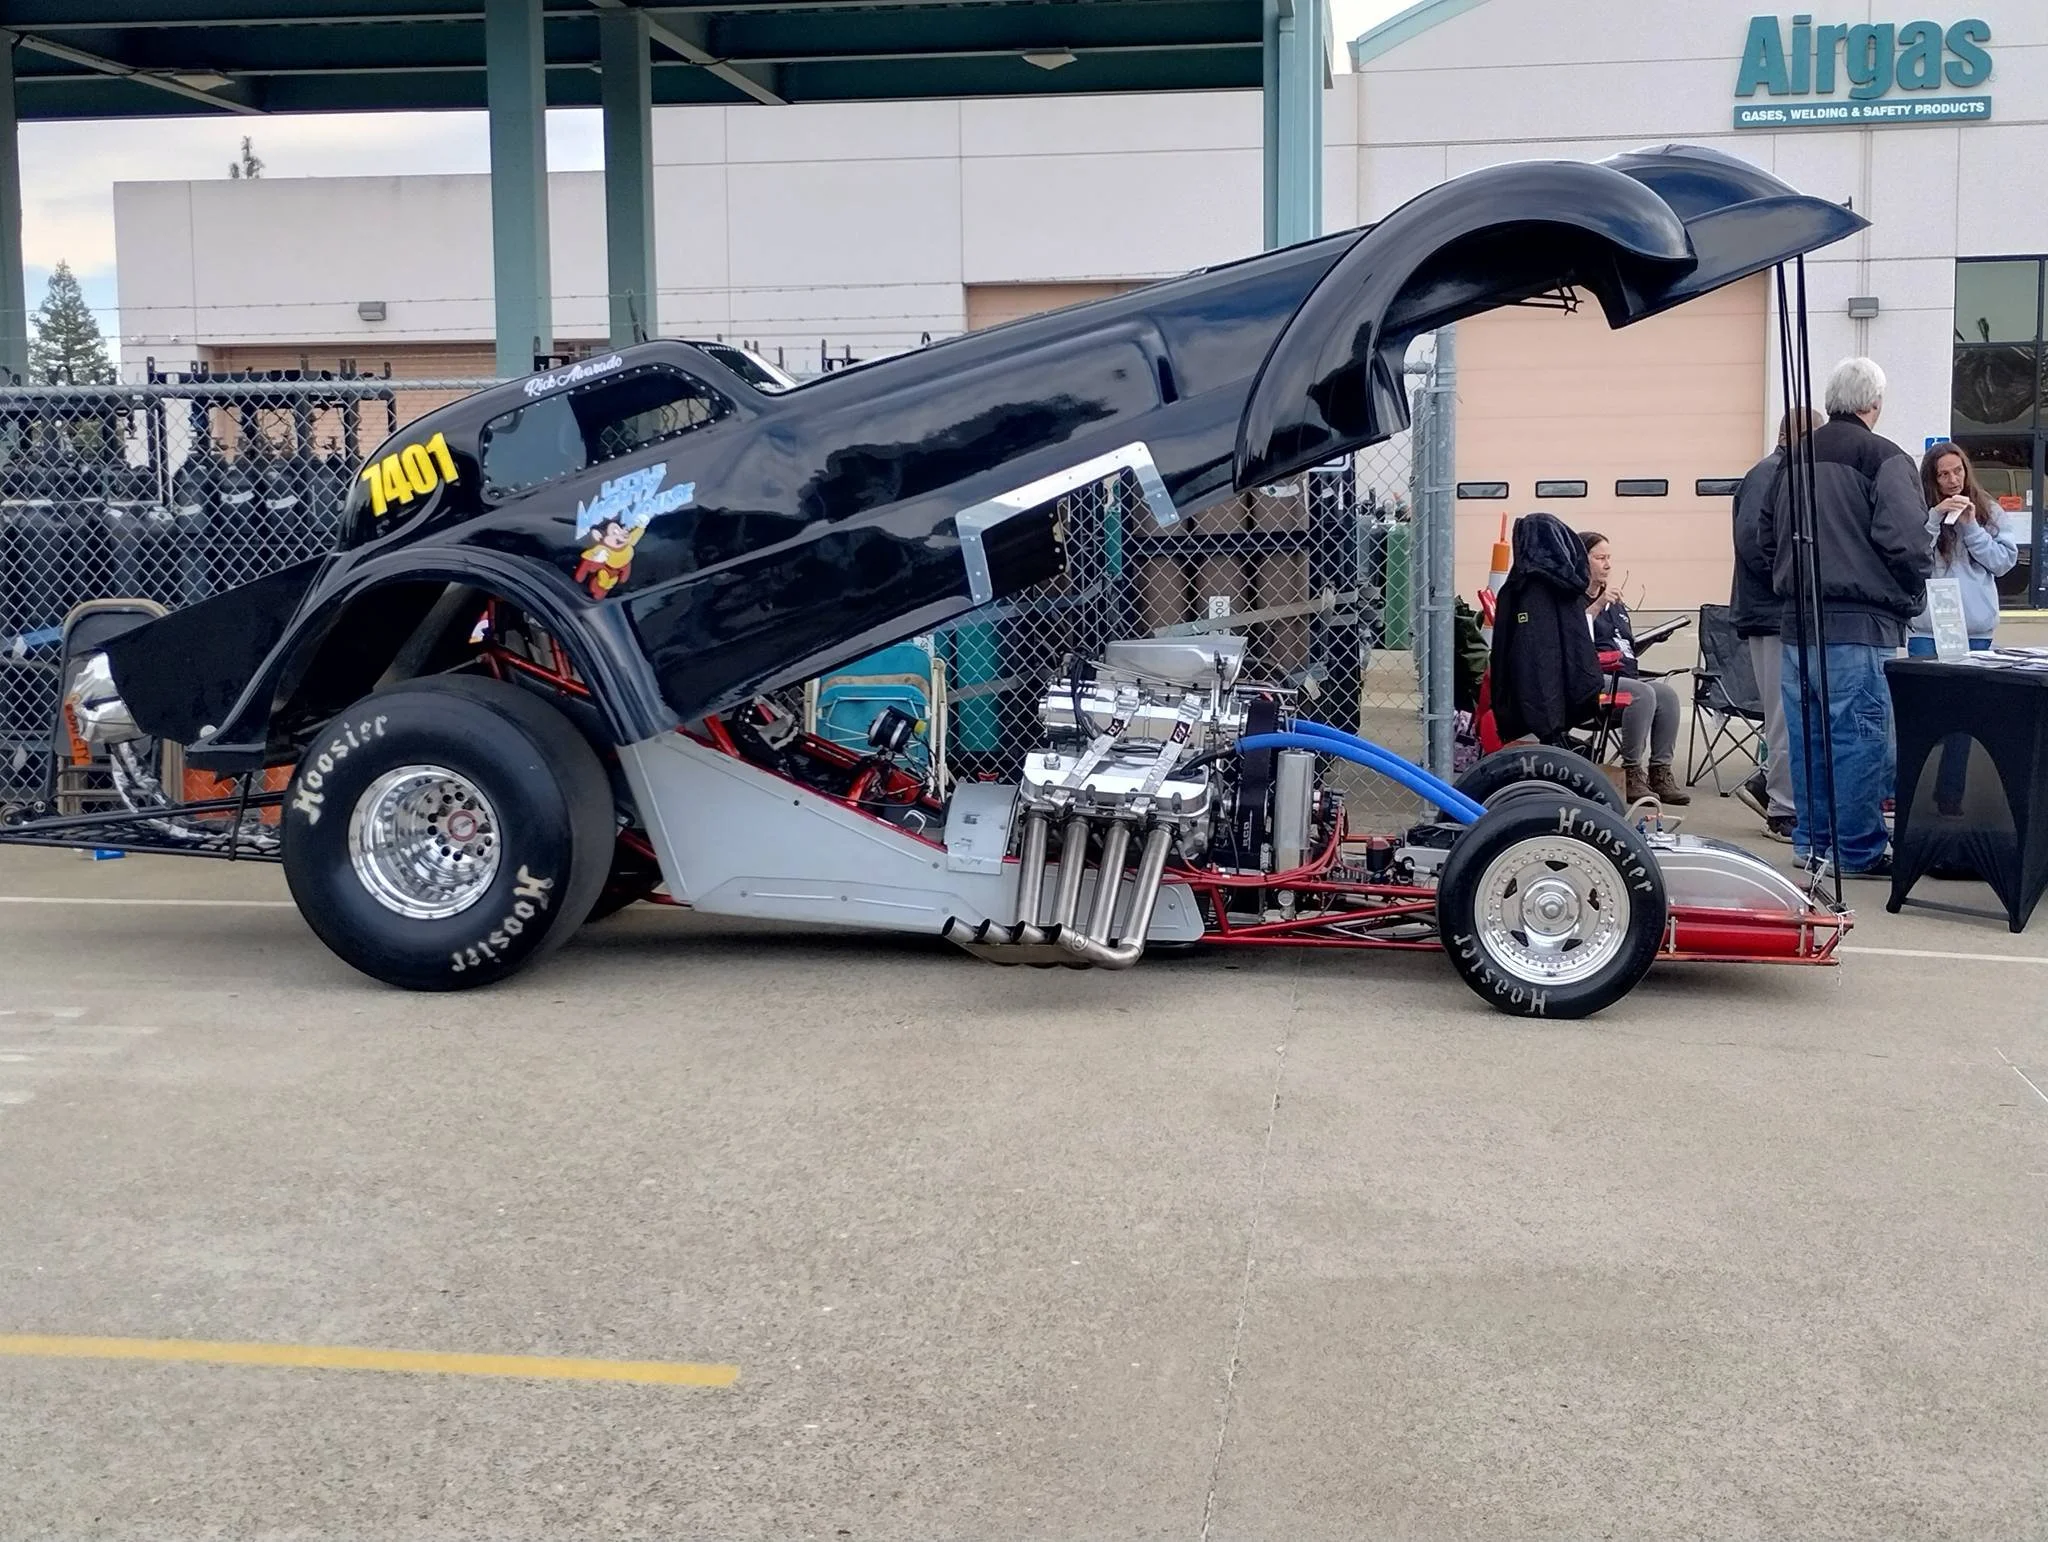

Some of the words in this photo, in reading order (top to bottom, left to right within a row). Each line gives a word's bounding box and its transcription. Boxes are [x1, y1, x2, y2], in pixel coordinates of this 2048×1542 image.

[1735, 14, 1992, 100] Airgas
[1741, 109, 1787, 123] GASES,
[1790, 106, 1848, 120] WELDING
[1851, 106, 1860, 117] &
[1863, 104, 1912, 117] SAFETY
[1915, 101, 1985, 115] PRODUCTS
[361, 432, 460, 518] 7401
[292, 715, 388, 825] Hoosier
[1551, 807, 1653, 893] Hoosier
[451, 864, 554, 973] Hoosier
[1452, 933, 1550, 1015] Hoosier
